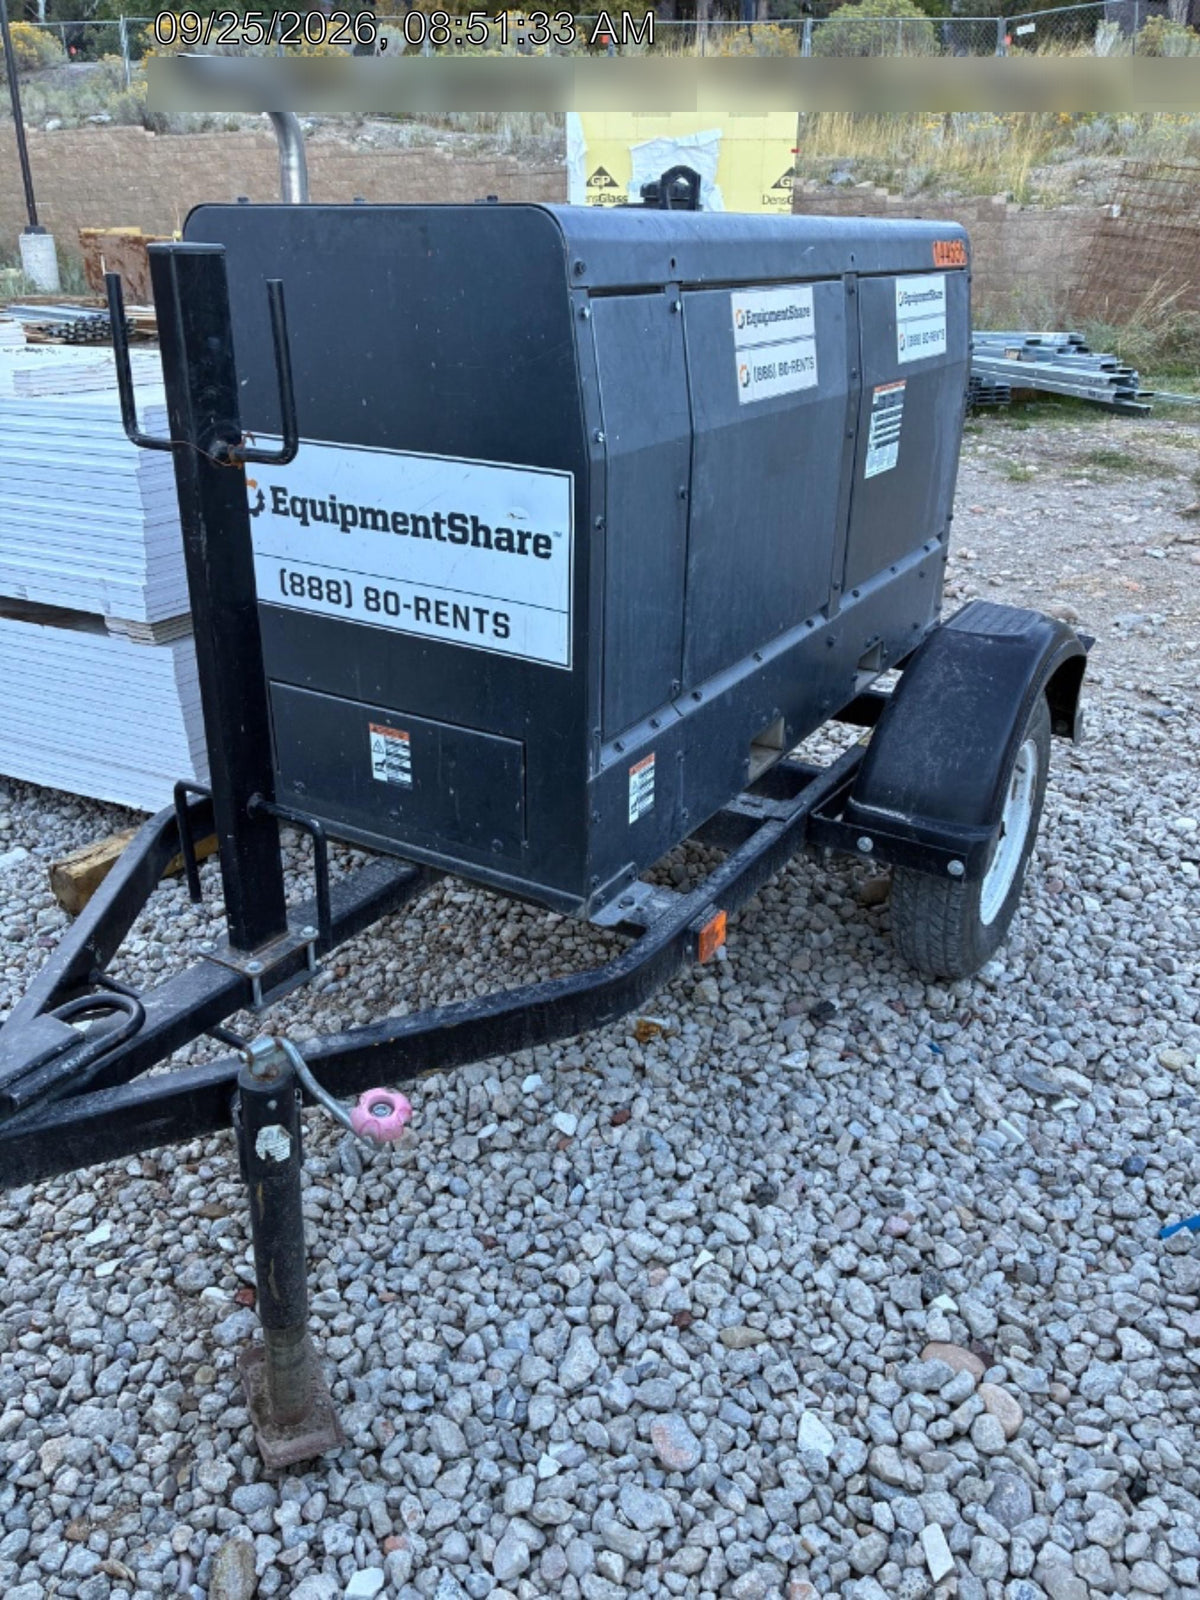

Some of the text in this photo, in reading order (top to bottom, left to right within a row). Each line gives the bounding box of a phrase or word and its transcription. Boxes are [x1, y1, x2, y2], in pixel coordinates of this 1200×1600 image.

[746, 305, 810, 328] EquipmentShare
[753, 357, 815, 383] (888) 80-RENTS
[270, 485, 552, 559] EquipmentShare
[279, 568, 511, 640] (888) 80-RENTS
